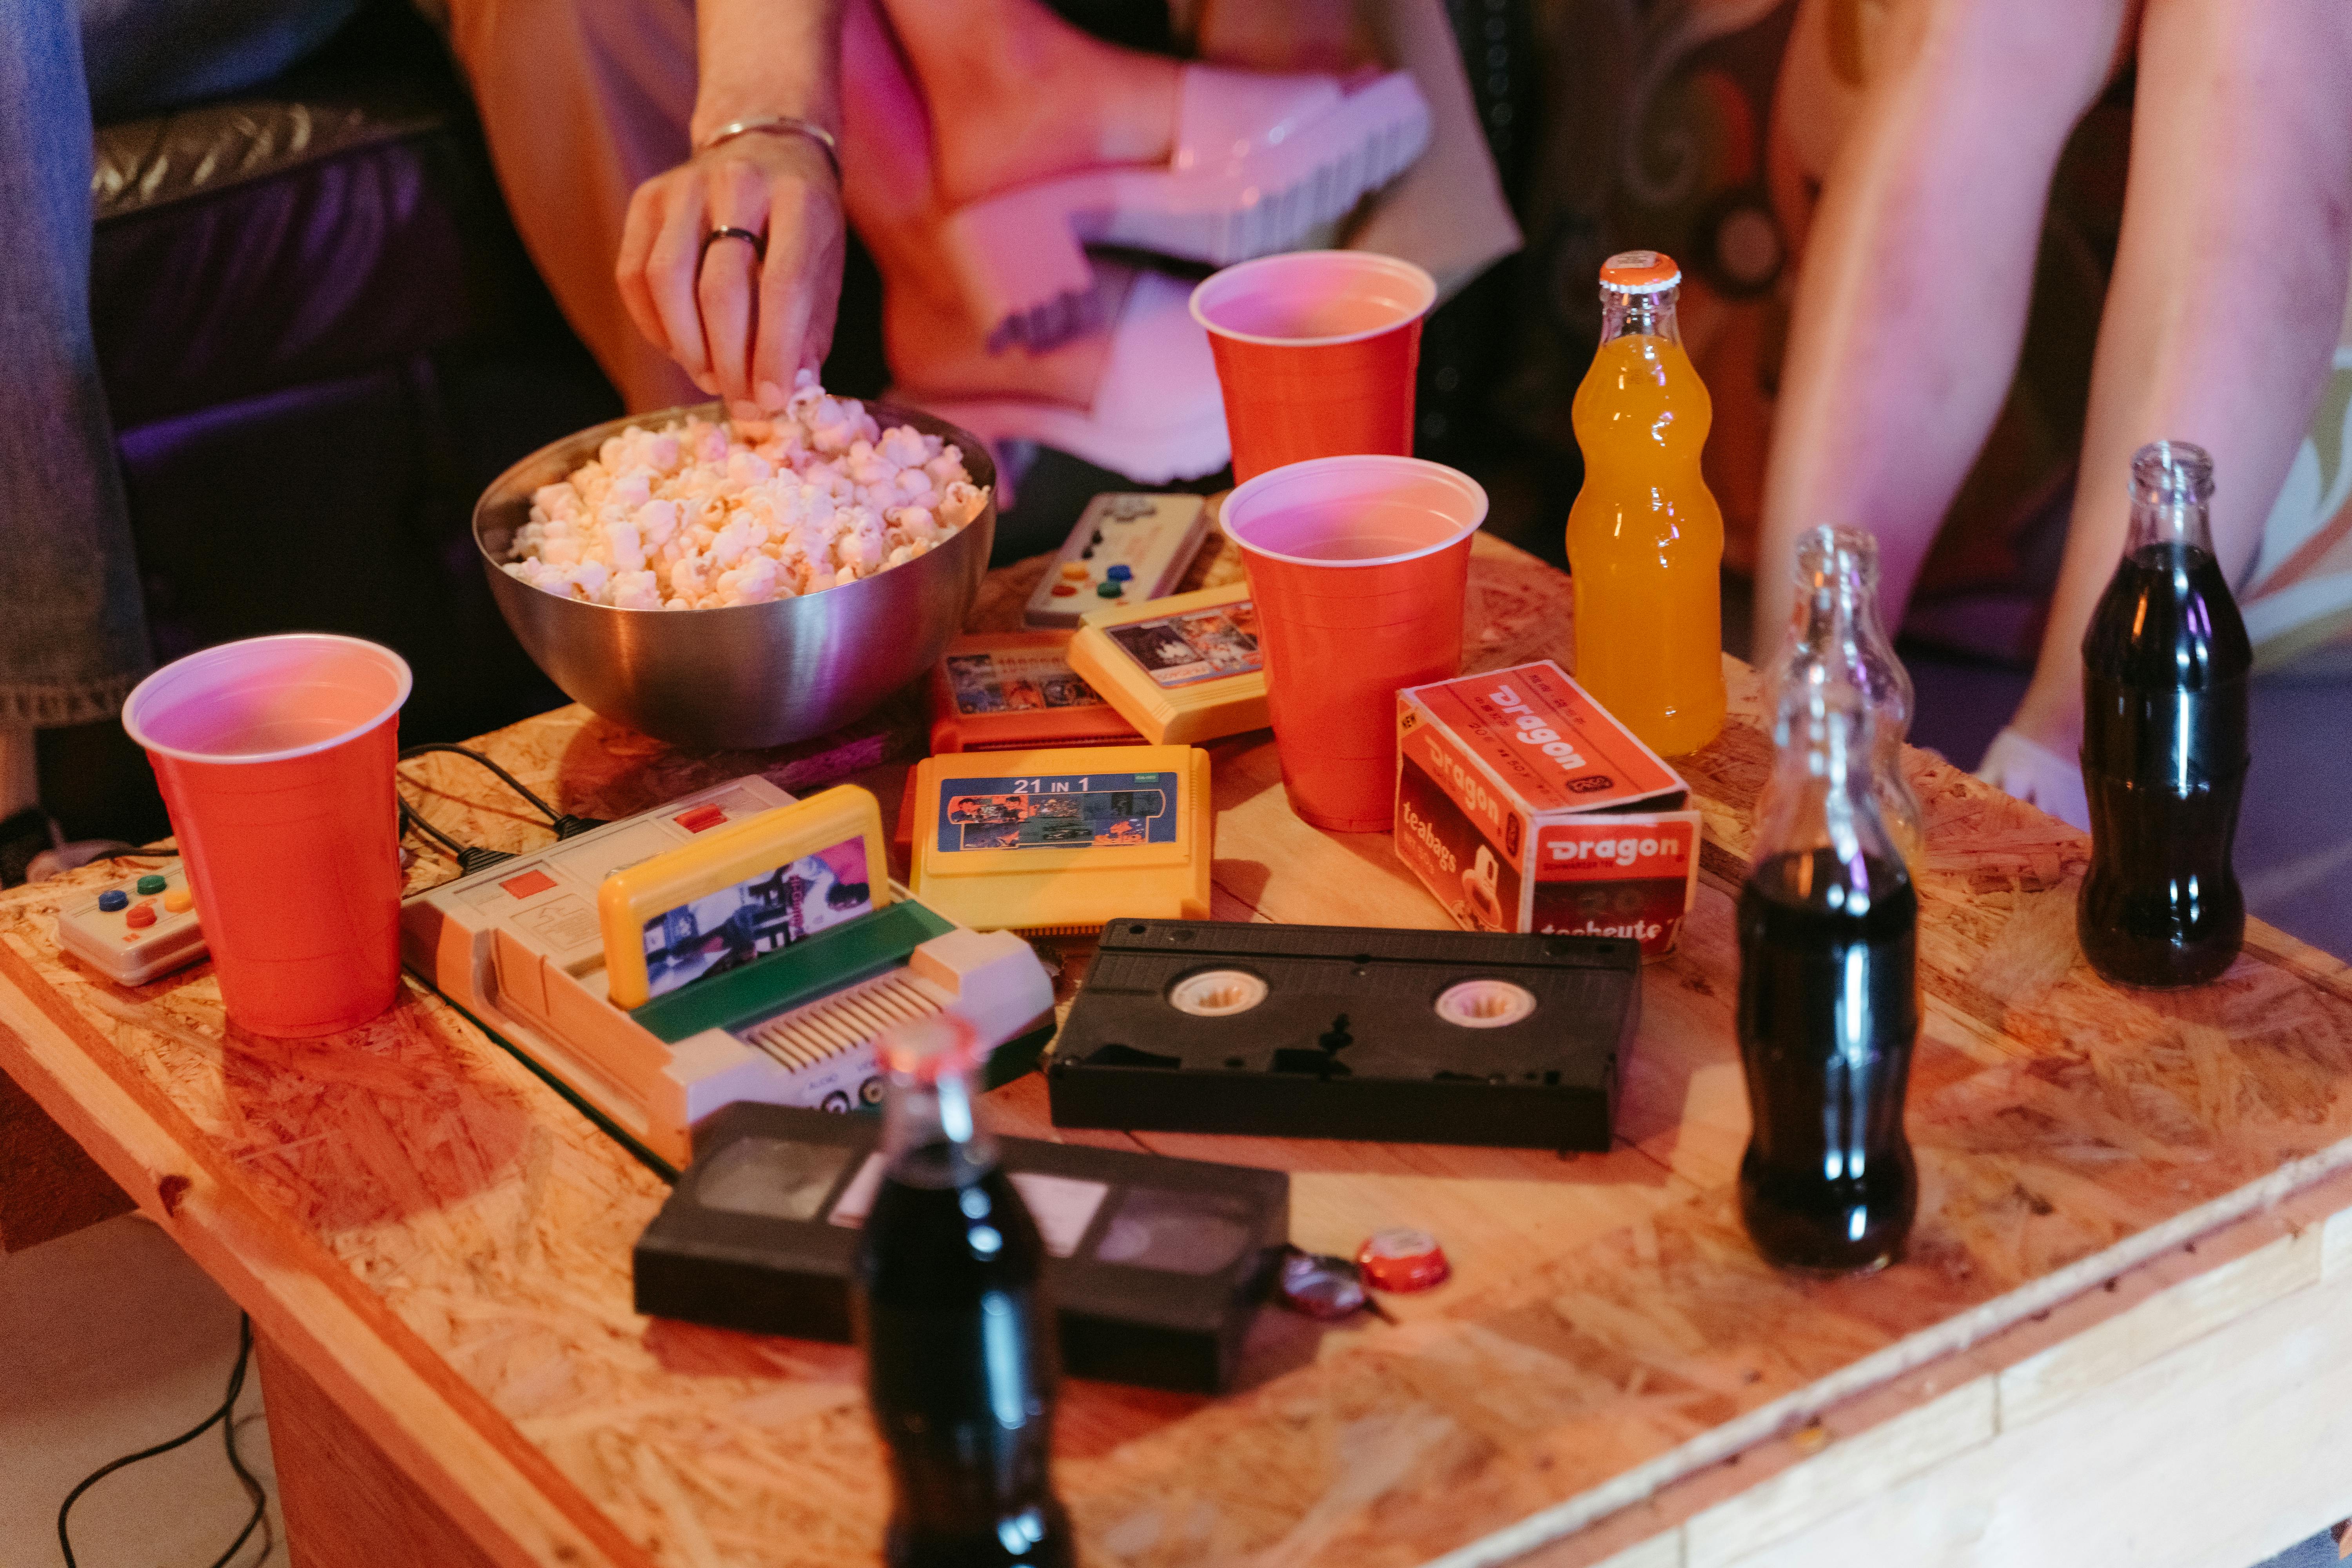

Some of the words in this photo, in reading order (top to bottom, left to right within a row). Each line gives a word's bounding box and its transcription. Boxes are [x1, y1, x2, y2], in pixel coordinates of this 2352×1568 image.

[1489, 684, 1586, 770] Dragon
[1013, 779, 1041, 794] 21
[1051, 782, 1069, 793] IN
[1078, 777, 1089, 791] 1
[1425, 734, 1499, 826] Dragon
[1403, 801, 1456, 873] teabags
[1547, 838, 1679, 866] Dragon
